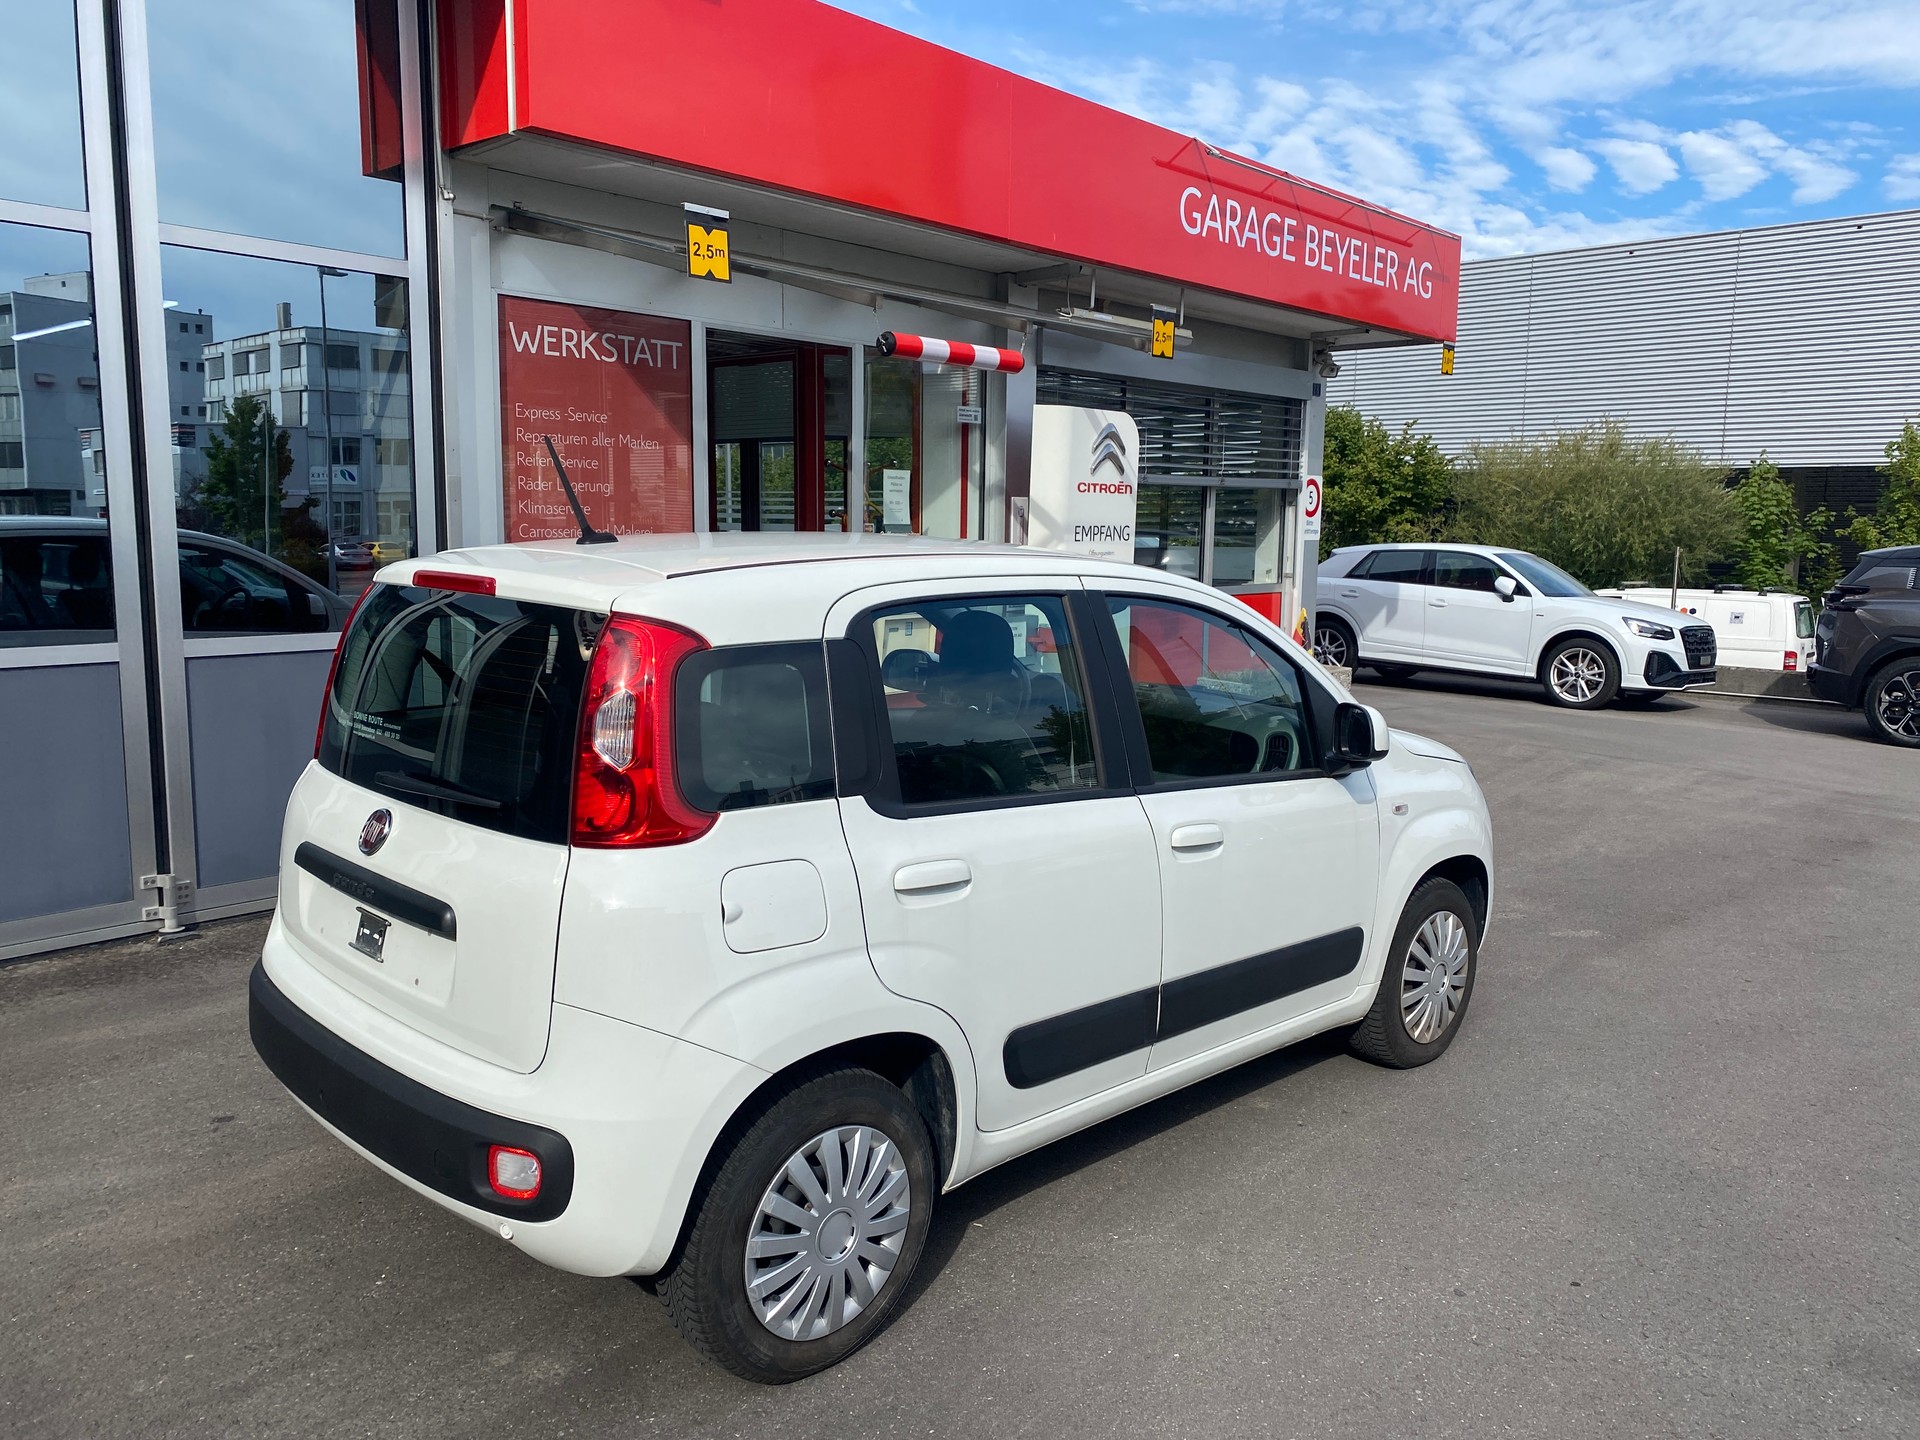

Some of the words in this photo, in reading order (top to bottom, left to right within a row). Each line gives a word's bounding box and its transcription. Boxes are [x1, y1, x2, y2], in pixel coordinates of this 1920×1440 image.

[692, 241, 725, 261] 2,5m
[1179, 186, 1297, 262] GARAGE
[1304, 223, 1399, 291] BEYELER
[1403, 257, 1433, 299] AG
[508, 321, 683, 370] WERKSTATT
[515, 402, 561, 422] Express
[516, 427, 588, 446] Reparaturen
[591, 432, 616, 447] aller
[619, 433, 660, 449] Marken
[517, 451, 554, 467] Reifen
[558, 453, 599, 470] Service
[517, 475, 553, 491] Räder
[557, 476, 611, 497] Lgerung
[1308, 490, 1314, 505] 5
[518, 500, 591, 516] Klimaserve
[518, 523, 583, 538] Carrosserie
[1074, 524, 1131, 542] EMPFANG
[363, 819, 384, 843] FIAT
